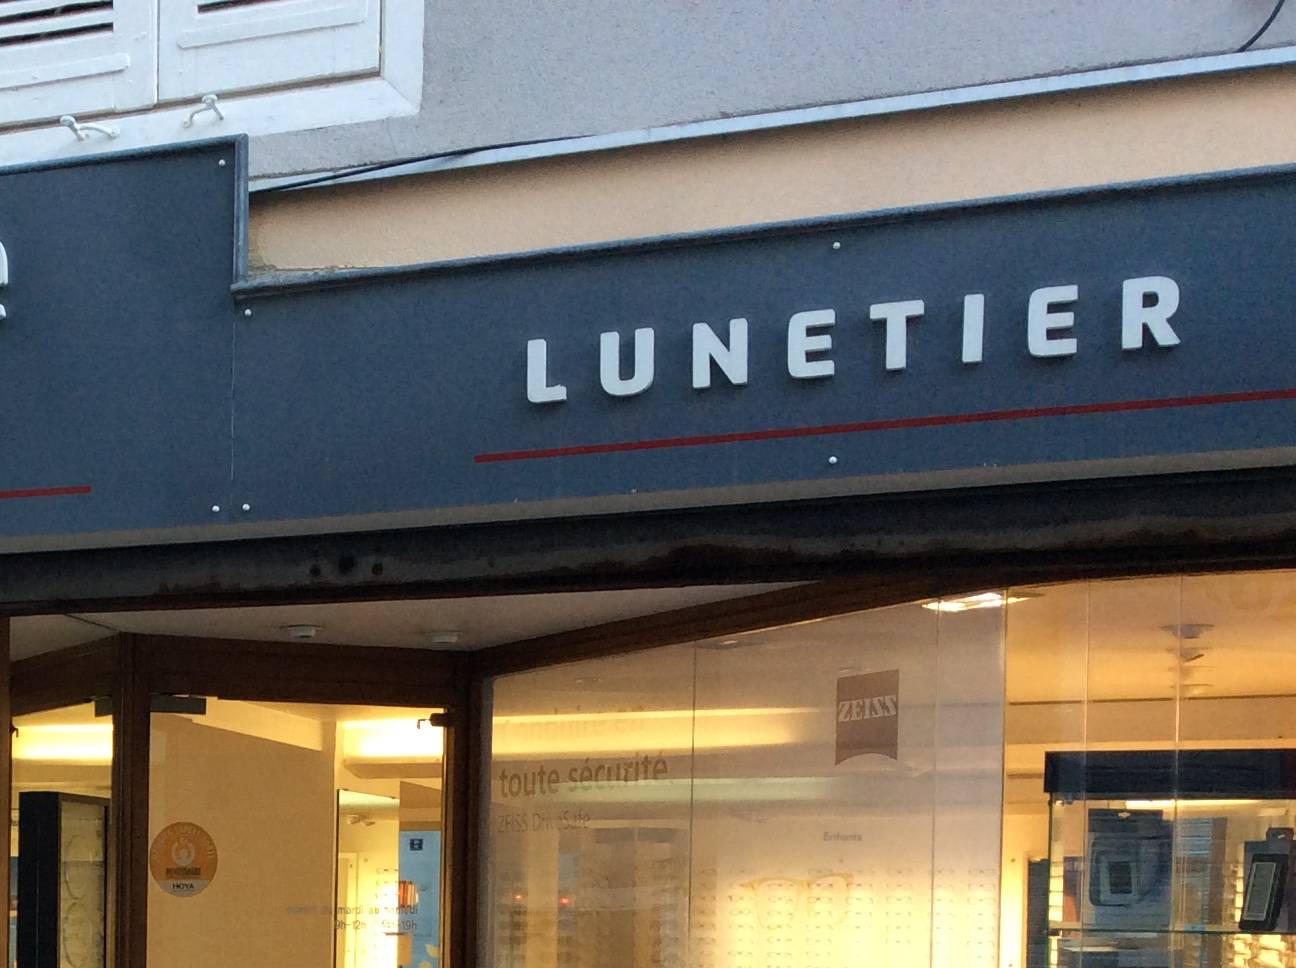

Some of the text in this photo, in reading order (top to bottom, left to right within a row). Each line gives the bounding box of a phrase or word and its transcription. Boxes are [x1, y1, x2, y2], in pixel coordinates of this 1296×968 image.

[526, 274, 1182, 404] LUNETIER
[838, 694, 897, 722] ZEISS
[499, 751, 668, 799] toute sécurité
[172, 882, 194, 890] HOYA
